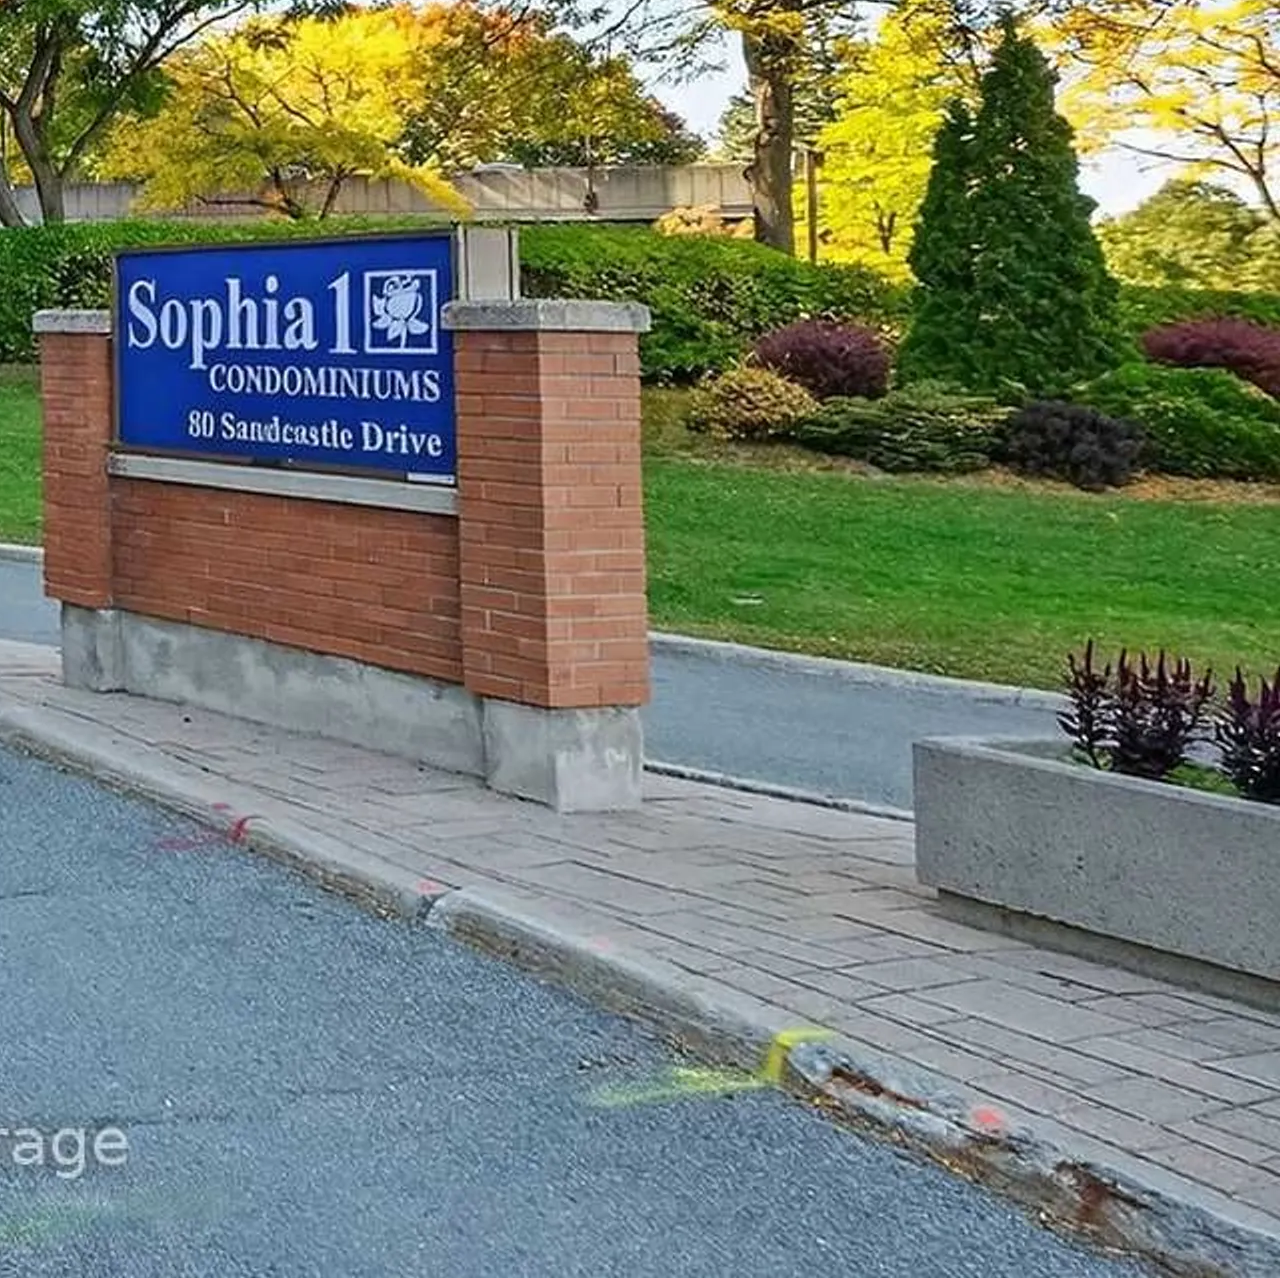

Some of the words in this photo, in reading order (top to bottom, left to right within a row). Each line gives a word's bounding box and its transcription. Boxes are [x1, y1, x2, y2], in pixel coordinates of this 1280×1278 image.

[128, 275, 318, 370] Sophia
[328, 272, 357, 354] 1
[209, 363, 441, 402] CONDOMINIUMS
[189, 409, 213, 438] 80
[221, 412, 354, 449] Sandcastle
[362, 421, 442, 457] Drive
